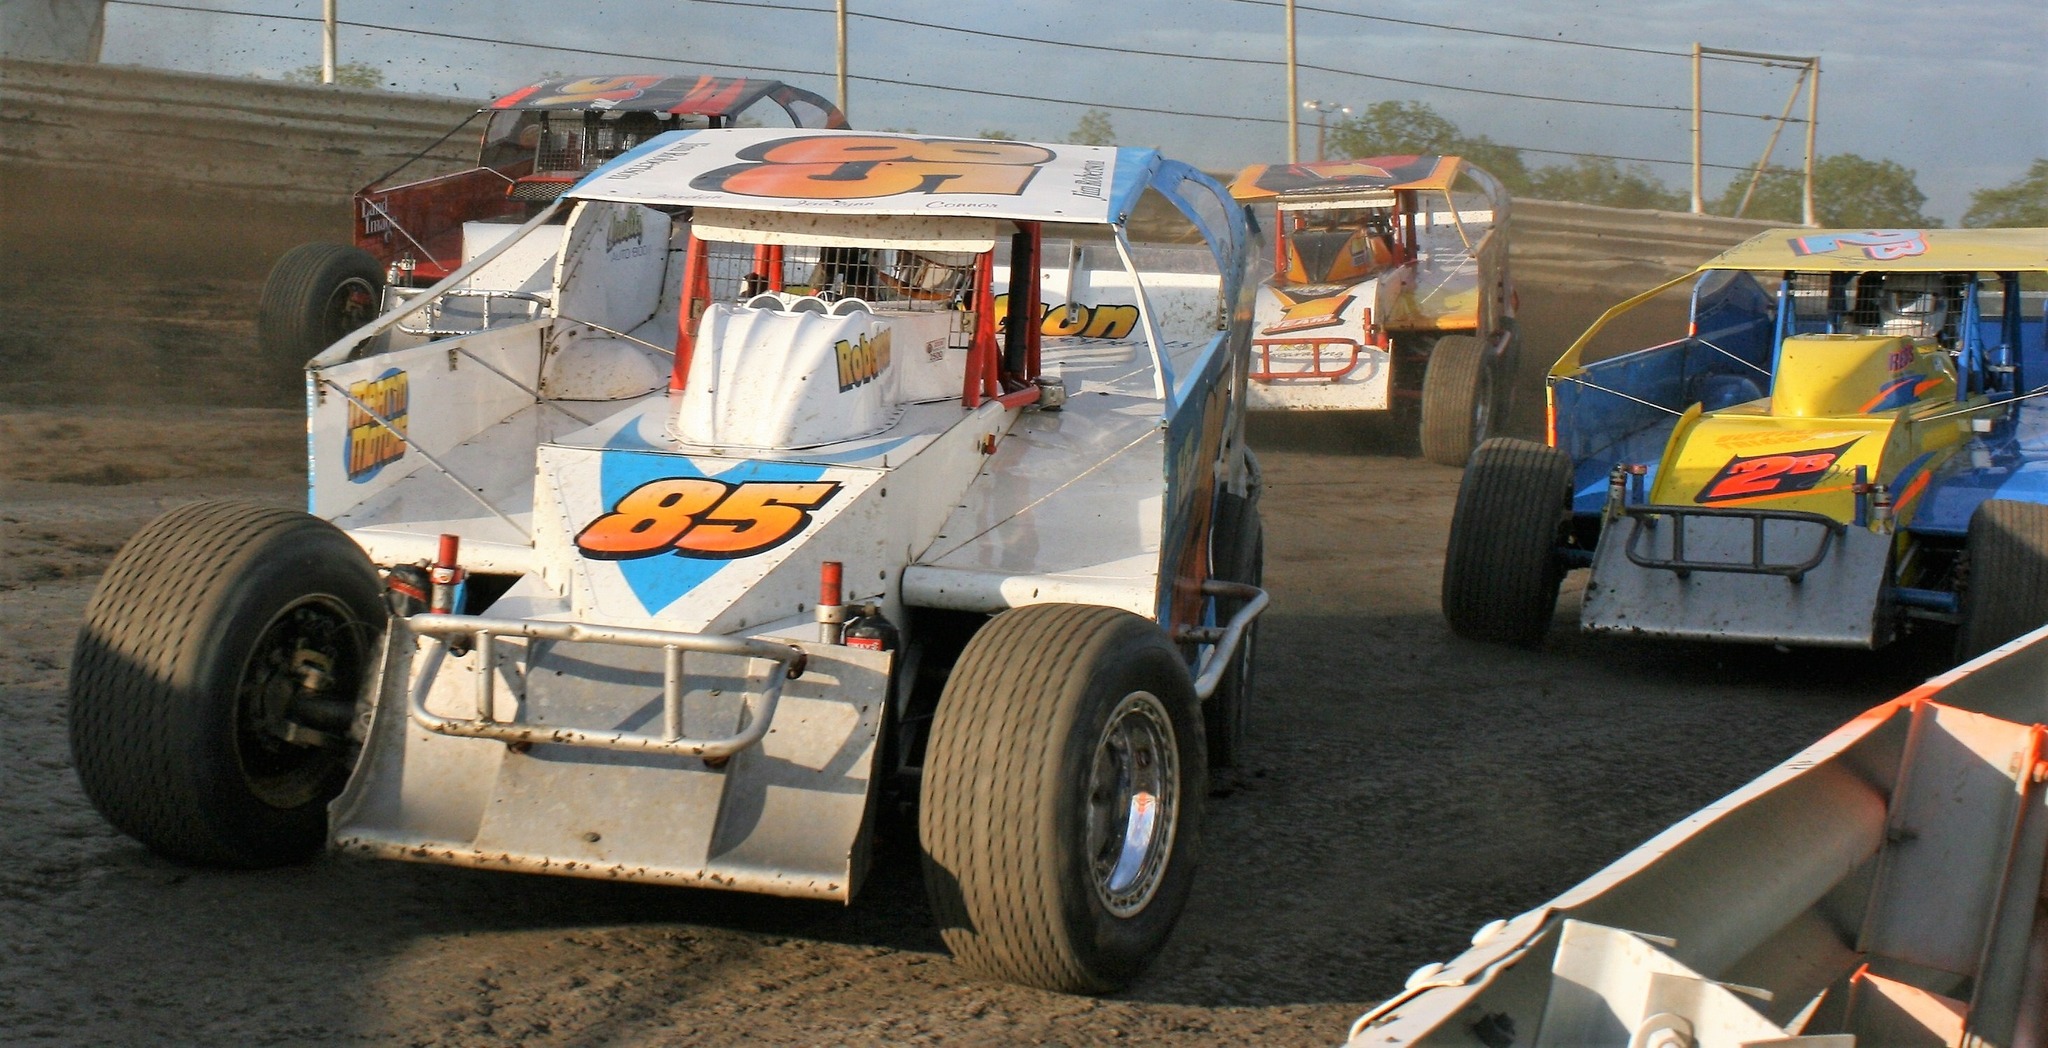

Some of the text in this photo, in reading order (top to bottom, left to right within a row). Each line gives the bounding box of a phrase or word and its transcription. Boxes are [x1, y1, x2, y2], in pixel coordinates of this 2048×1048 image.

[688, 135, 1057, 200] 85
[1787, 228, 1931, 261] 2B
[1706, 453, 1837, 499] 2B
[574, 476, 842, 560] 85
